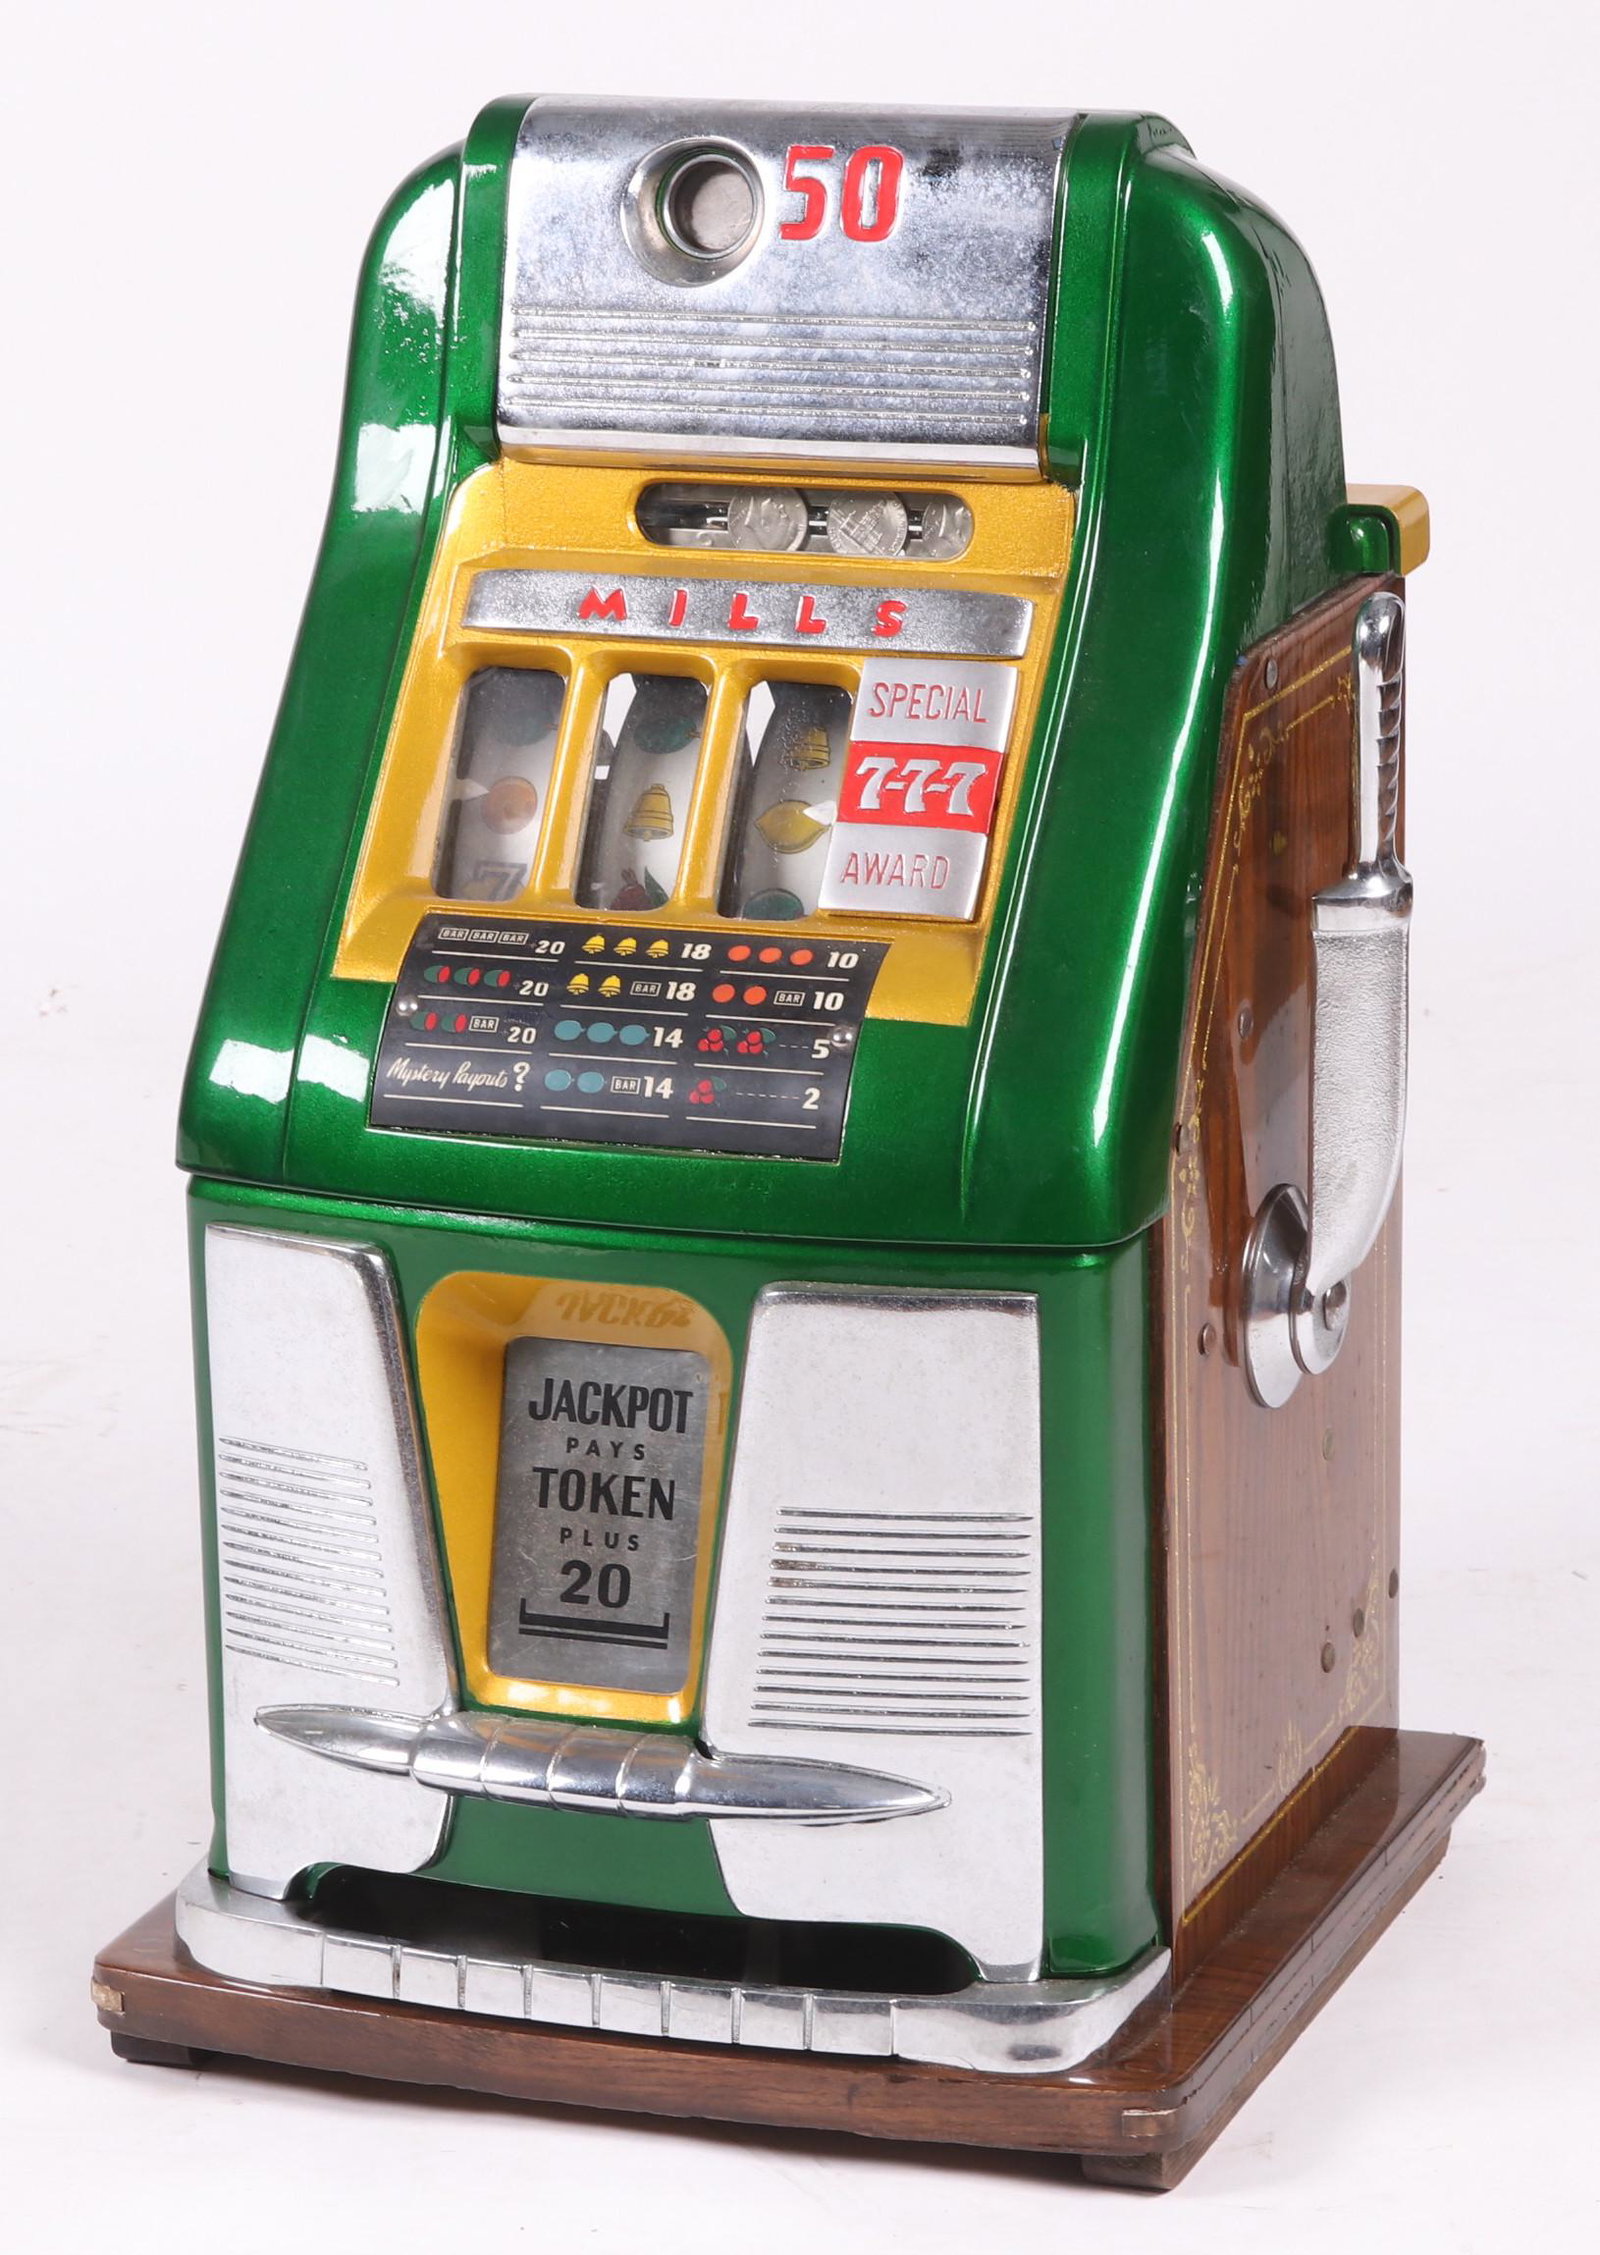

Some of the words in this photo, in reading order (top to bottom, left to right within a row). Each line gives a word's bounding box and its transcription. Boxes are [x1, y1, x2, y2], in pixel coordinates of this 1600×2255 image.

[780, 144, 904, 242] 50
[577, 587, 907, 638] MILLS
[869, 682, 988, 723] SPECIAL
[855, 756, 988, 817] 7-7-7
[840, 852, 951, 889] AWARD
[535, 940, 566, 955] 20
[681, 943, 712, 960] 18
[827, 951, 859, 969] 10
[519, 980, 549, 997] 20
[633, 983, 658, 995] BAR
[666, 981, 696, 1002] 18
[777, 992, 802, 1005] BAR
[812, 991, 844, 1011] 10
[472, 1017, 496, 1031] BAR
[507, 1026, 537, 1044] 20
[653, 1026, 683, 1049] 14
[811, 1038, 830, 1059] 5
[386, 1057, 450, 1089] Mystery
[513, 1061, 530, 1092] ?
[613, 1081, 638, 1094] BAR
[643, 1075, 674, 1099] 14
[802, 1087, 821, 1110] 2
[528, 1377, 694, 1435] JACKPOT
[565, 1437, 647, 1461] PAYS
[532, 1466, 675, 1521] TOKEN
[559, 1527, 640, 1552] PLUS
[559, 1559, 632, 1609] 20
